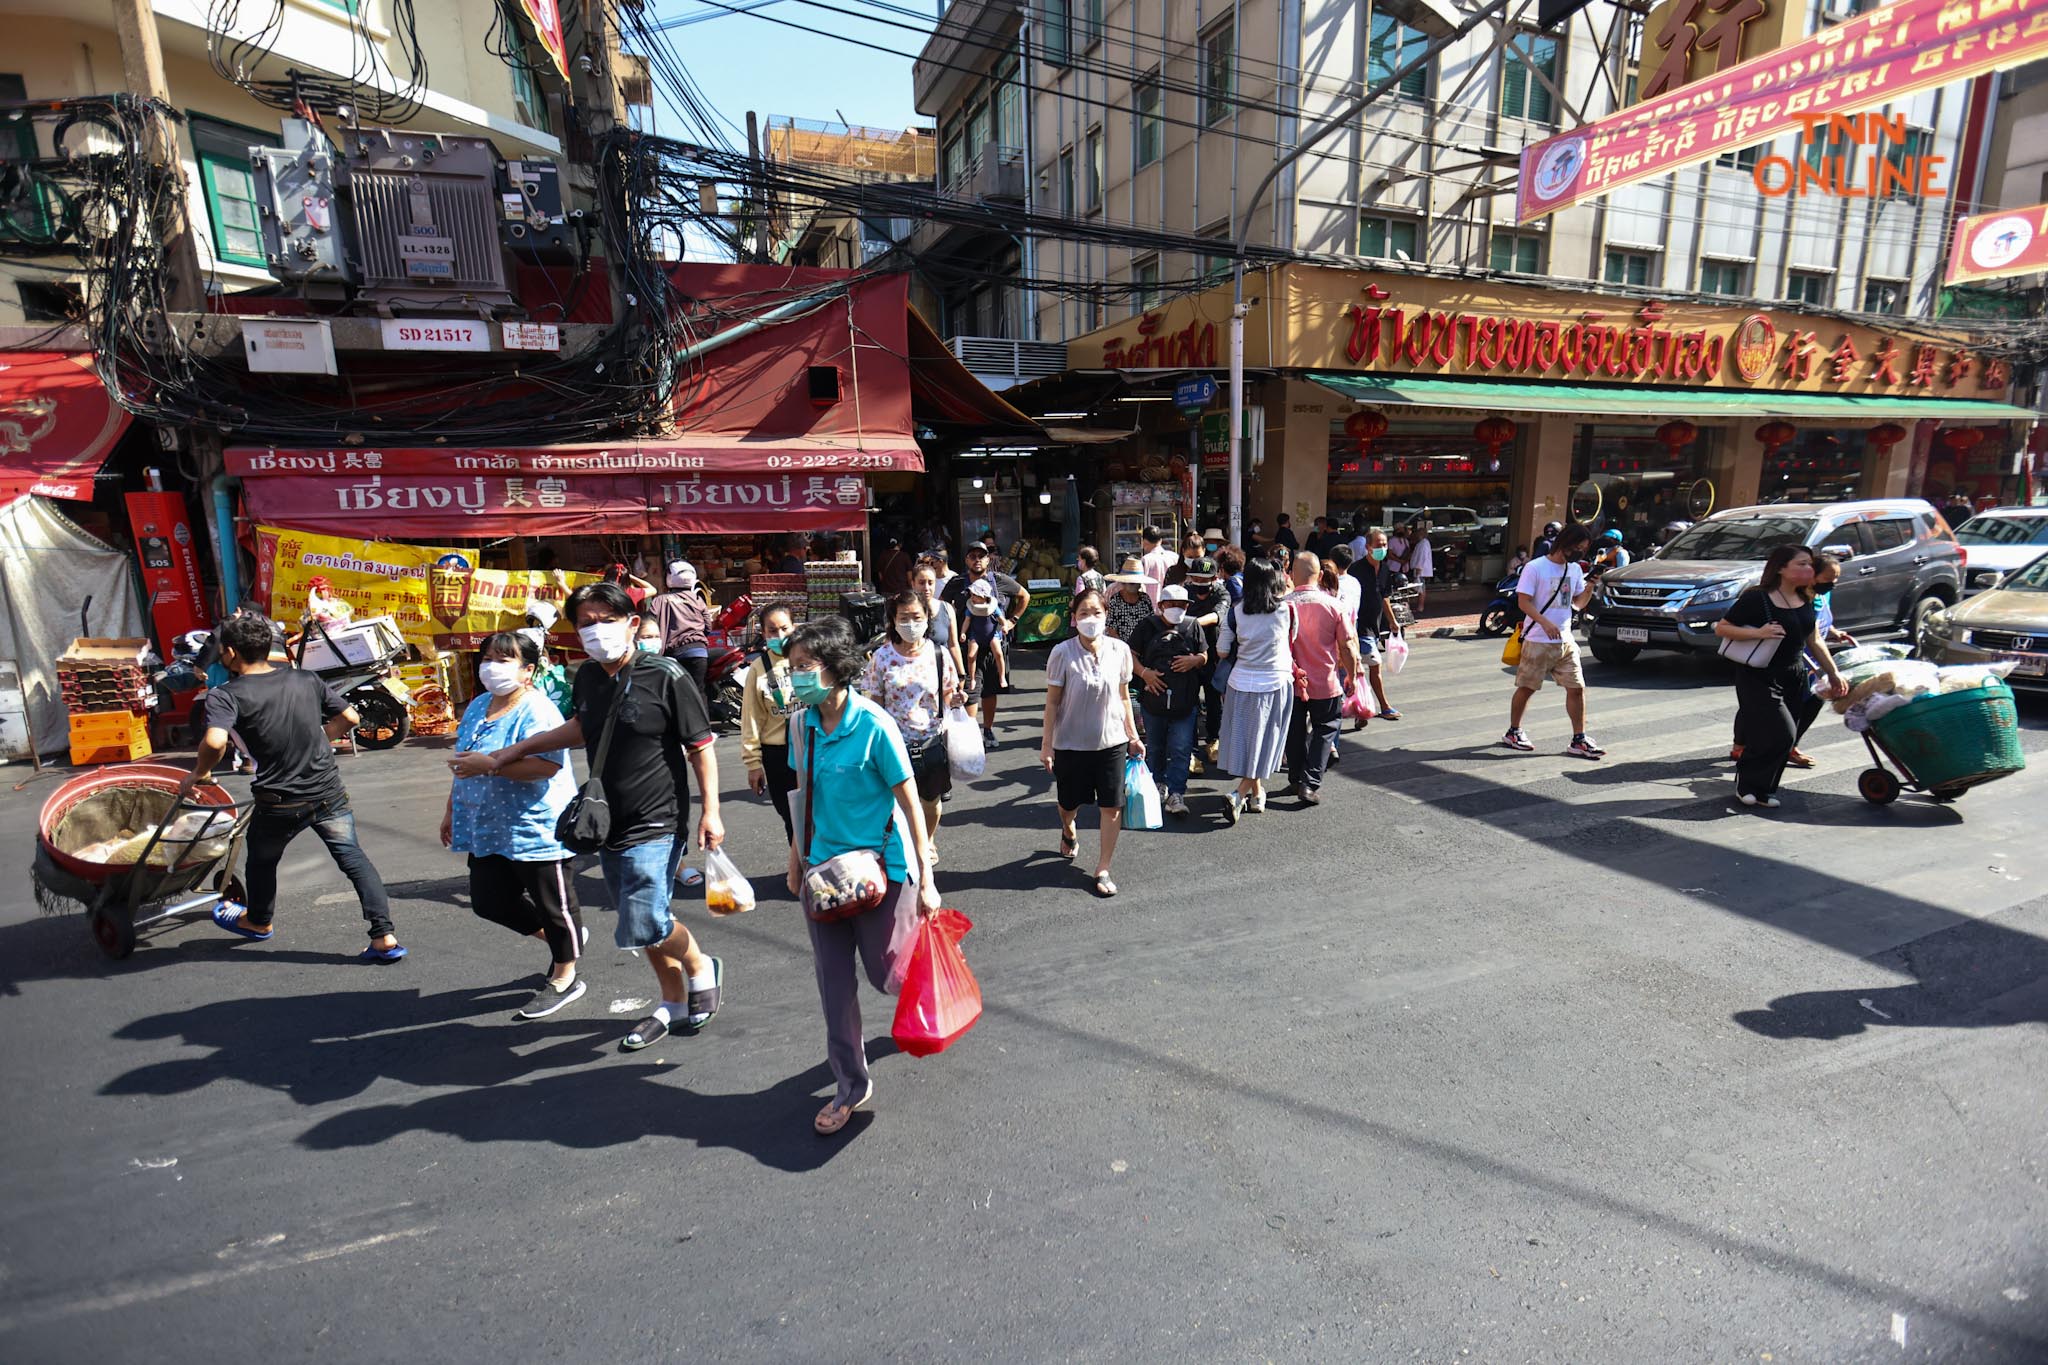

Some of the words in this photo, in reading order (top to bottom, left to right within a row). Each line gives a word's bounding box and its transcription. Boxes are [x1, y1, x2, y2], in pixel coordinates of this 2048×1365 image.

[413, 226, 435, 235] 500
[404, 246, 450, 255] LL-1328
[400, 328, 421, 341] SD
[425, 329, 473, 342] 21517
[1203, 383, 1210, 396] 6
[249, 451, 336, 473] เชี่ยงปู่
[343, 452, 383, 469] 長富
[454, 454, 520, 470] เกาลัด
[531, 452, 704, 470] เจ้าแรกในเมืองไทย
[767, 454, 893, 468] 02-222-2219
[336, 475, 487, 514] เชี่ยงปู่
[503, 476, 566, 509] 長富
[660, 472, 792, 511] เชี่ยงป่
[802, 475, 863, 505] 長富
[302, 551, 427, 582] ตราเด็กสมบูรณ์
[182, 548, 204, 619] EMERGENCY
[1631, 588, 1660, 596] ISUZU
